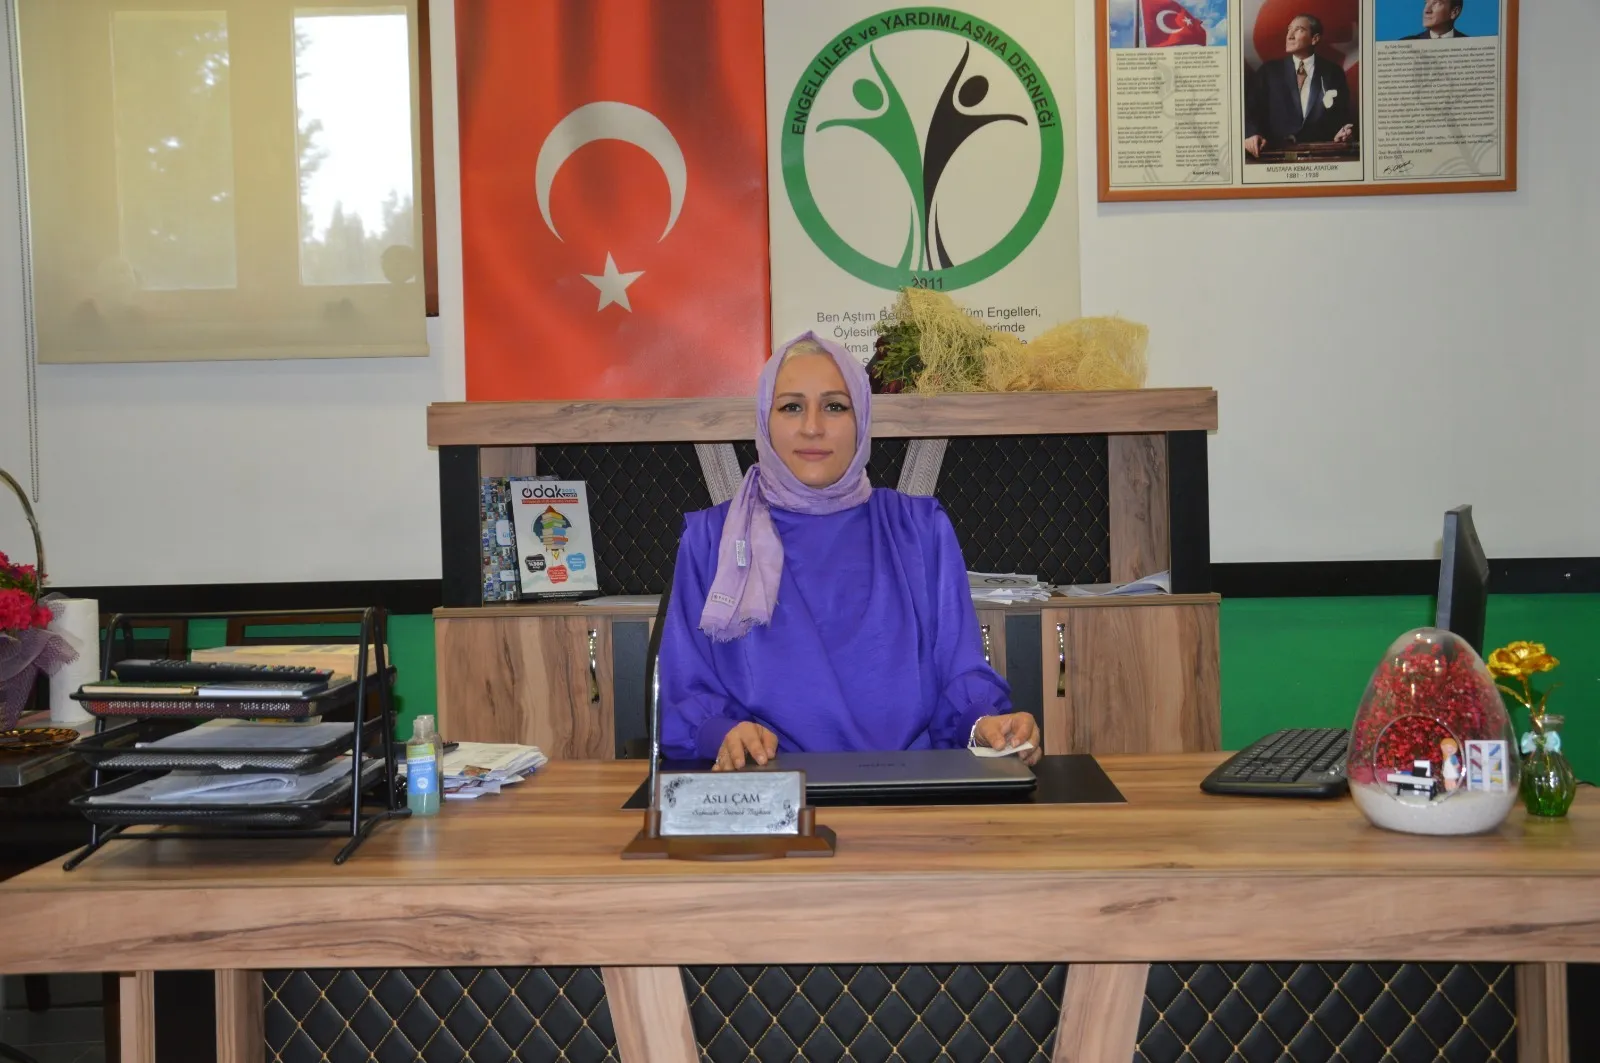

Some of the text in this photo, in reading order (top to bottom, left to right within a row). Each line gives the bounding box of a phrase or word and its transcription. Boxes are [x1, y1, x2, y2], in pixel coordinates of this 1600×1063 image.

[792, 35, 857, 135] ENGELLİLER
[858, 25, 878, 40] ve
[880, 12, 1008, 56] YARDIMLAŞMA
[1007, 52, 1056, 129] DERNEĞİ
[1313, 164, 1339, 172] ATATÜRK
[911, 276, 943, 290] 2011
[816, 312, 840, 323] Ben
[842, 311, 876, 324] Aştım
[987, 306, 1042, 320] Engelleri,
[702, 792, 761, 805] ASLI ÇAM
